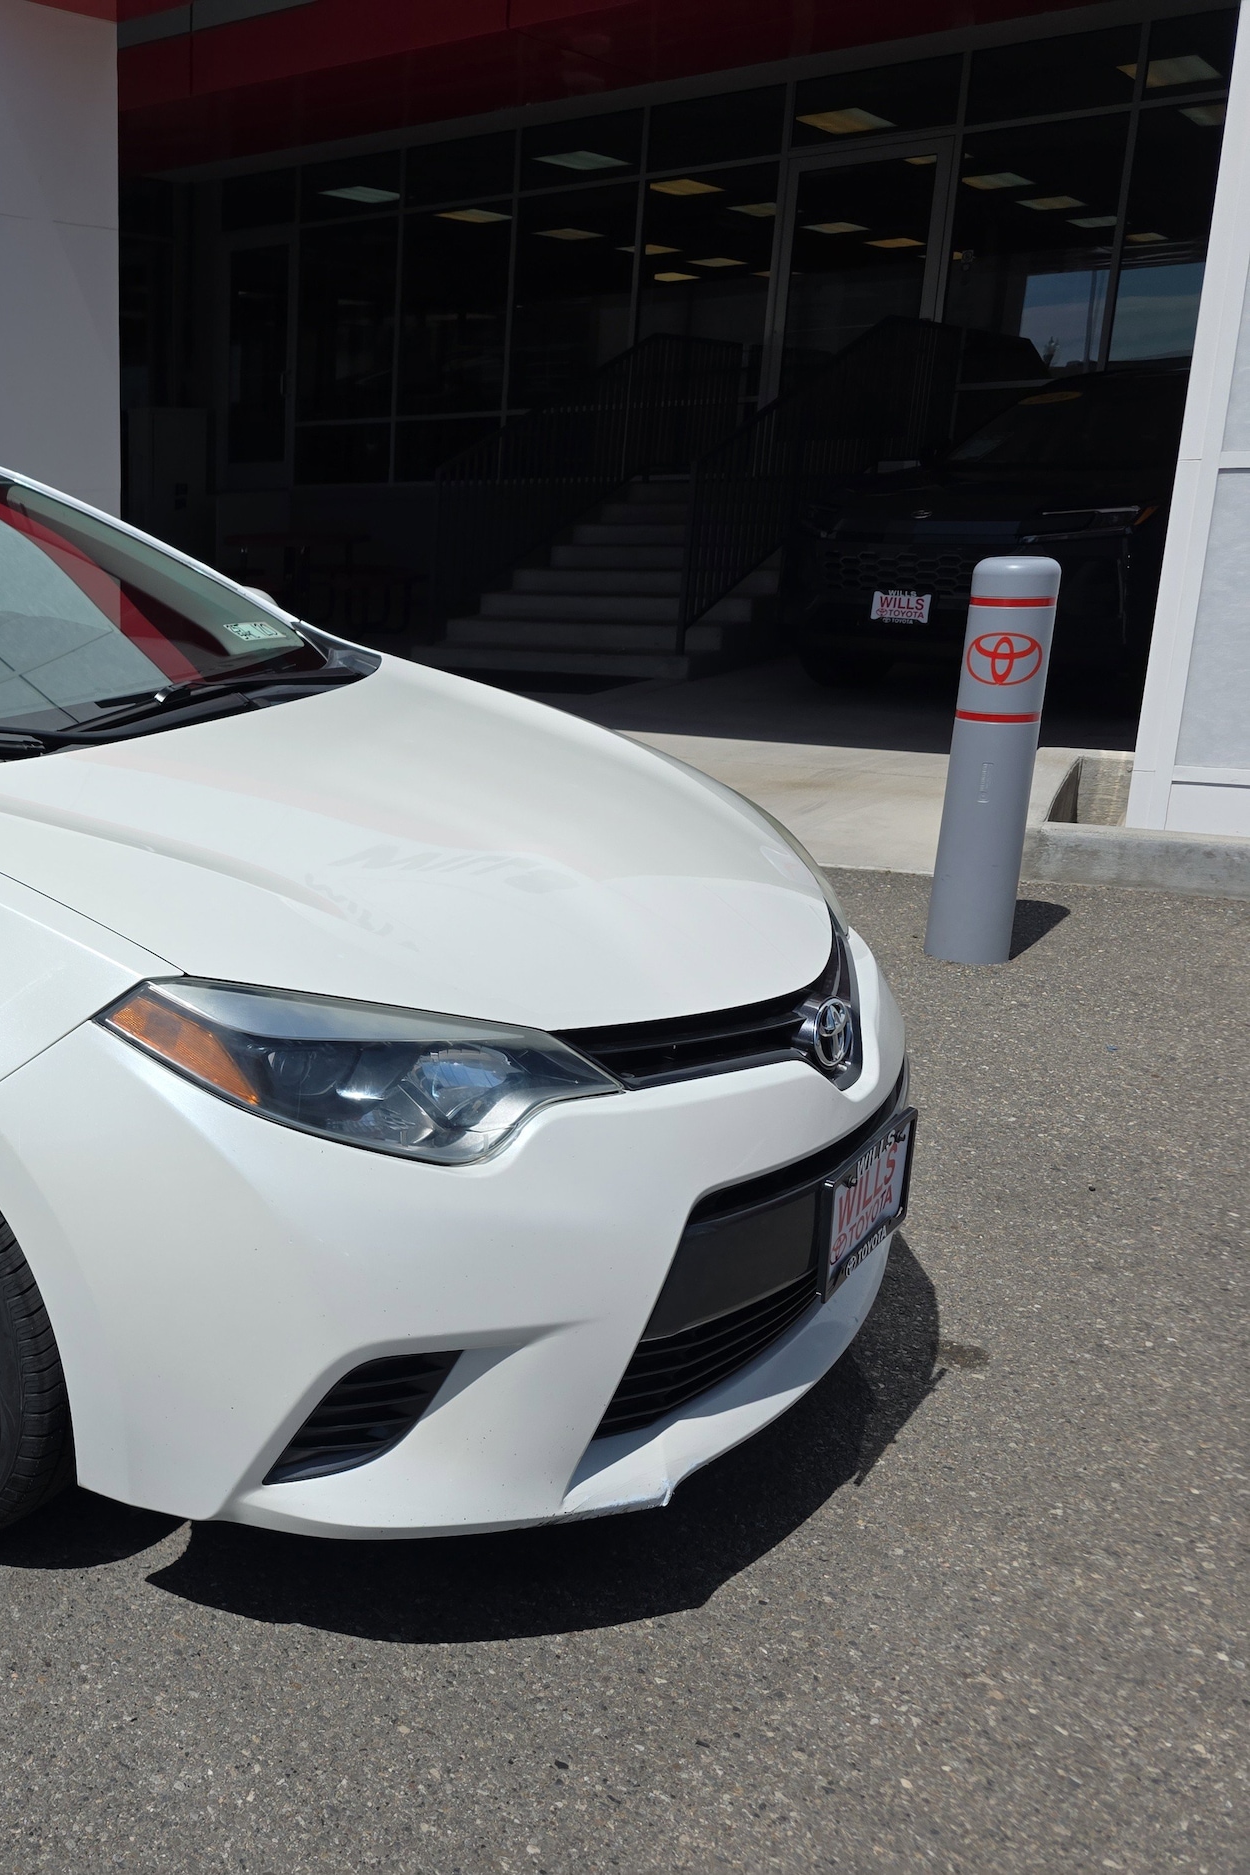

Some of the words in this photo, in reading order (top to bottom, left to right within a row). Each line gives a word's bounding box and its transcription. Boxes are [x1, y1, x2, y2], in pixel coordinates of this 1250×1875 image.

[880, 596, 924, 611] WILLS
[889, 609, 924, 619] TOYOTA
[857, 1129, 895, 1177] WILLS
[838, 1142, 897, 1233] WILLS
[849, 1184, 892, 1247] TOYOTA
[857, 1224, 887, 1265] TOYOTA
